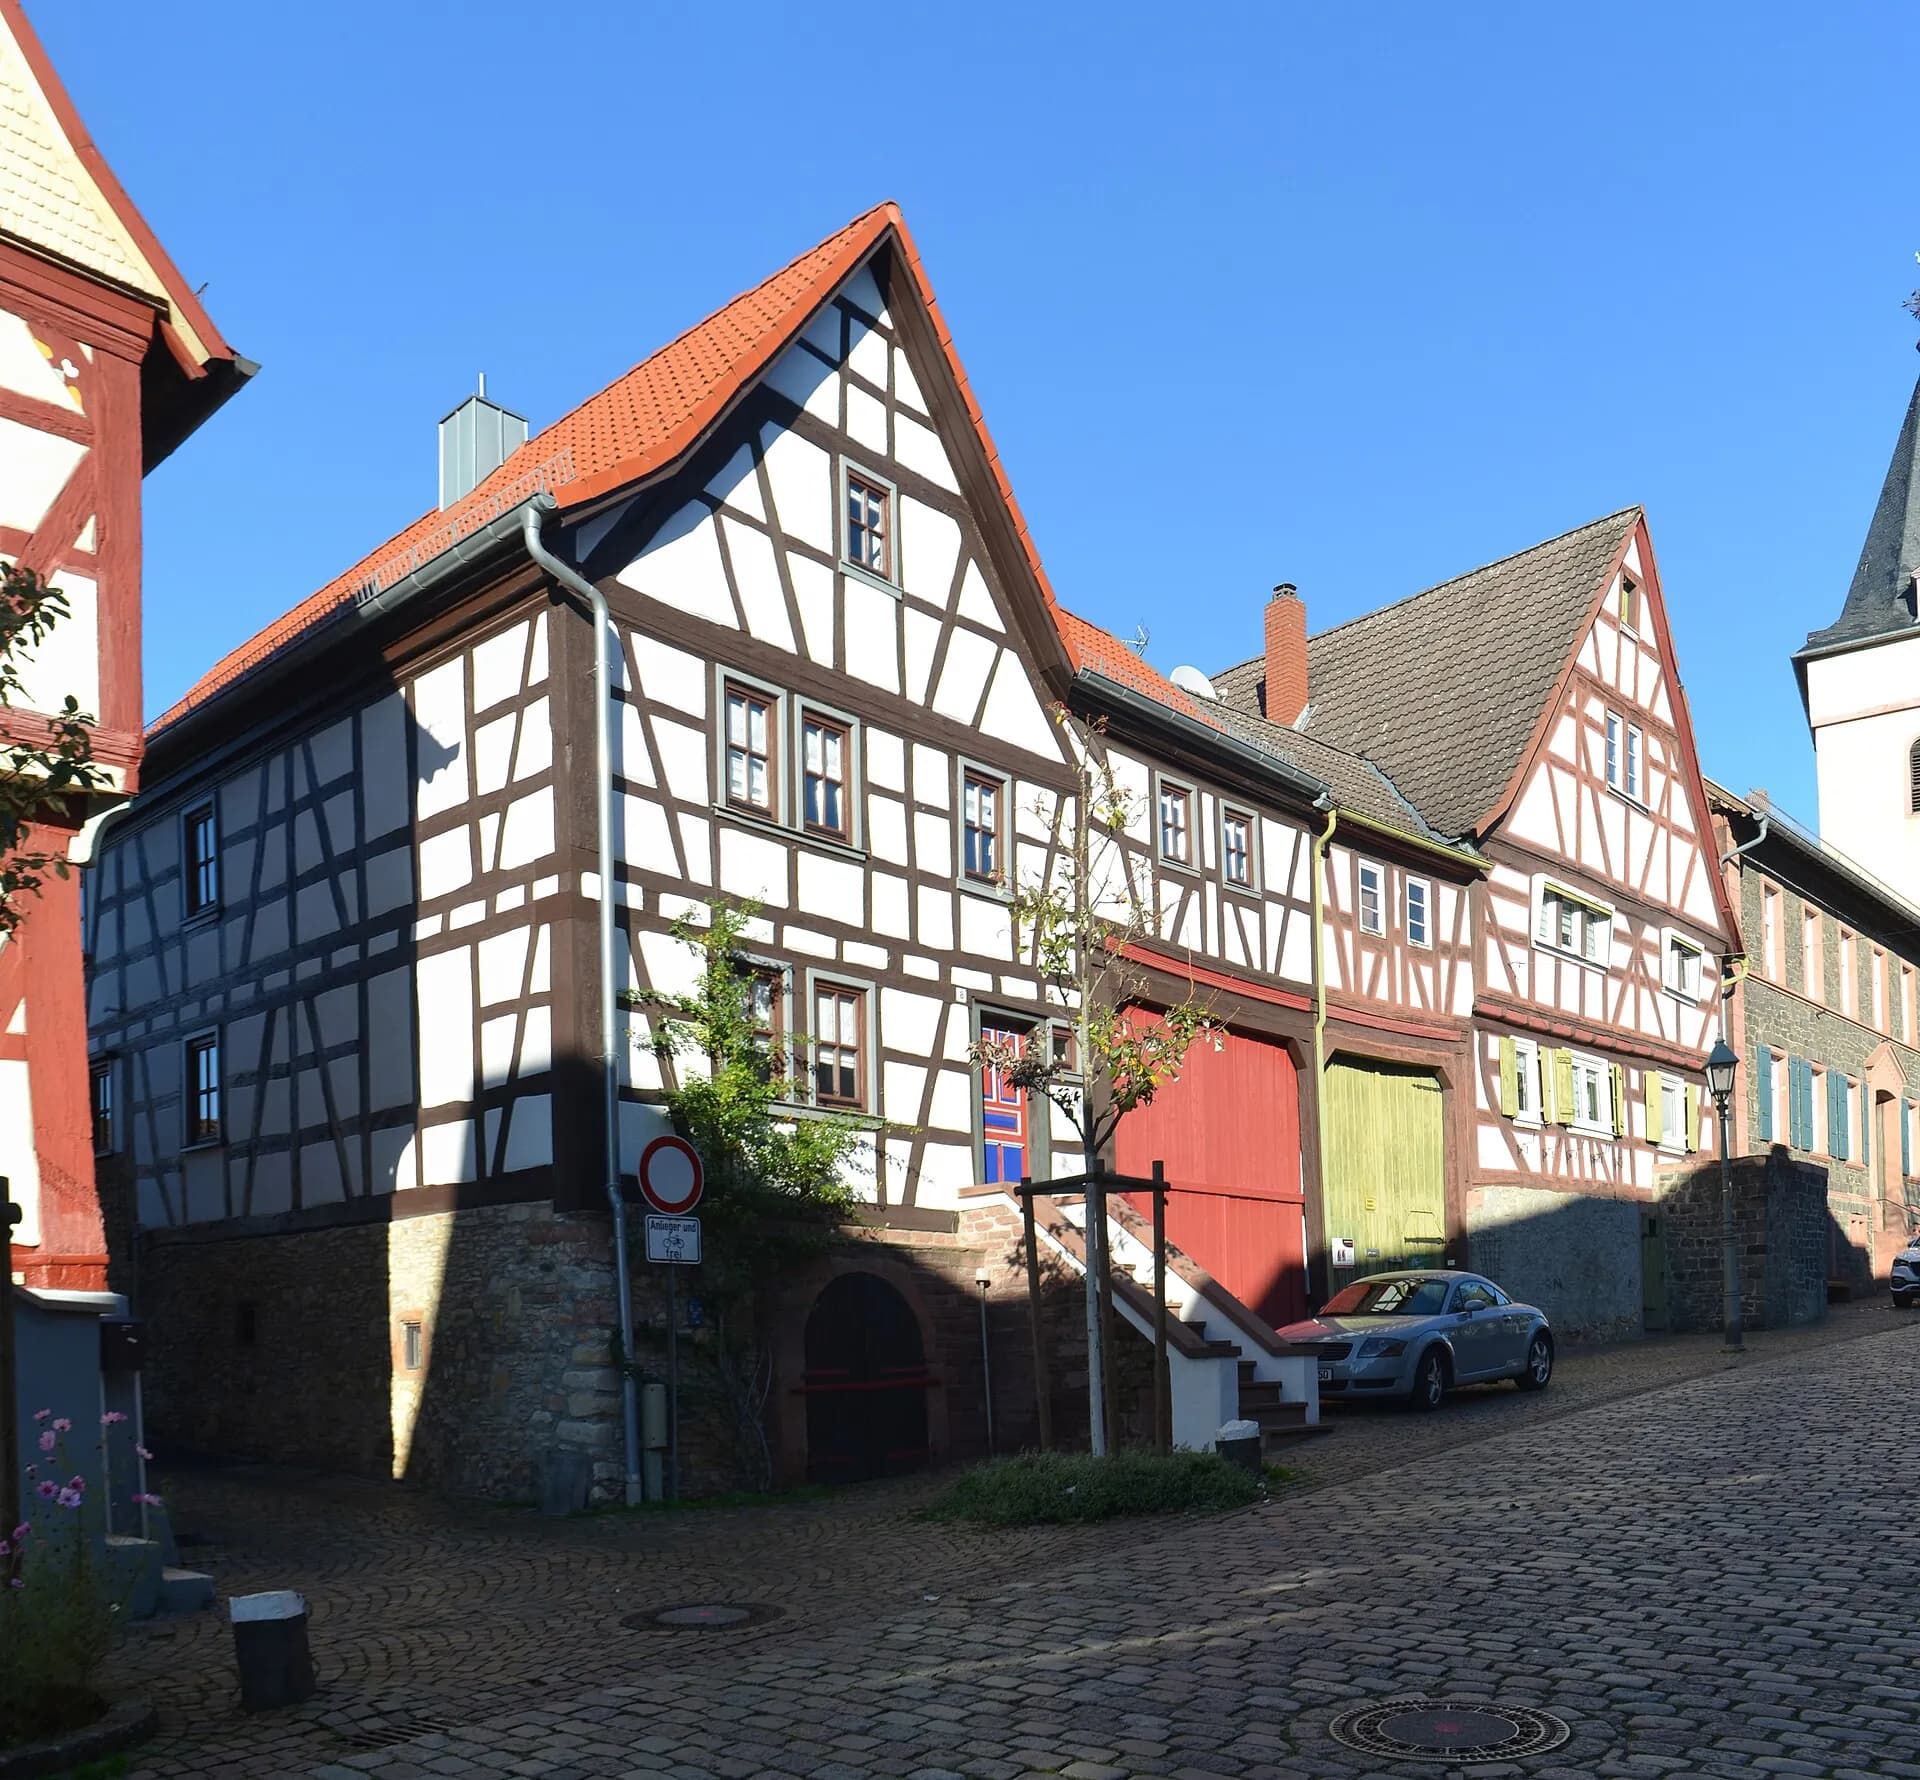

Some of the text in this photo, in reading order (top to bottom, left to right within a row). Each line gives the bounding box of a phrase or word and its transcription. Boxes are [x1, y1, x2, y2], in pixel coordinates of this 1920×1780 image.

[650, 1219, 697, 1233] Anlieger und
[666, 1247, 682, 1259] frei
